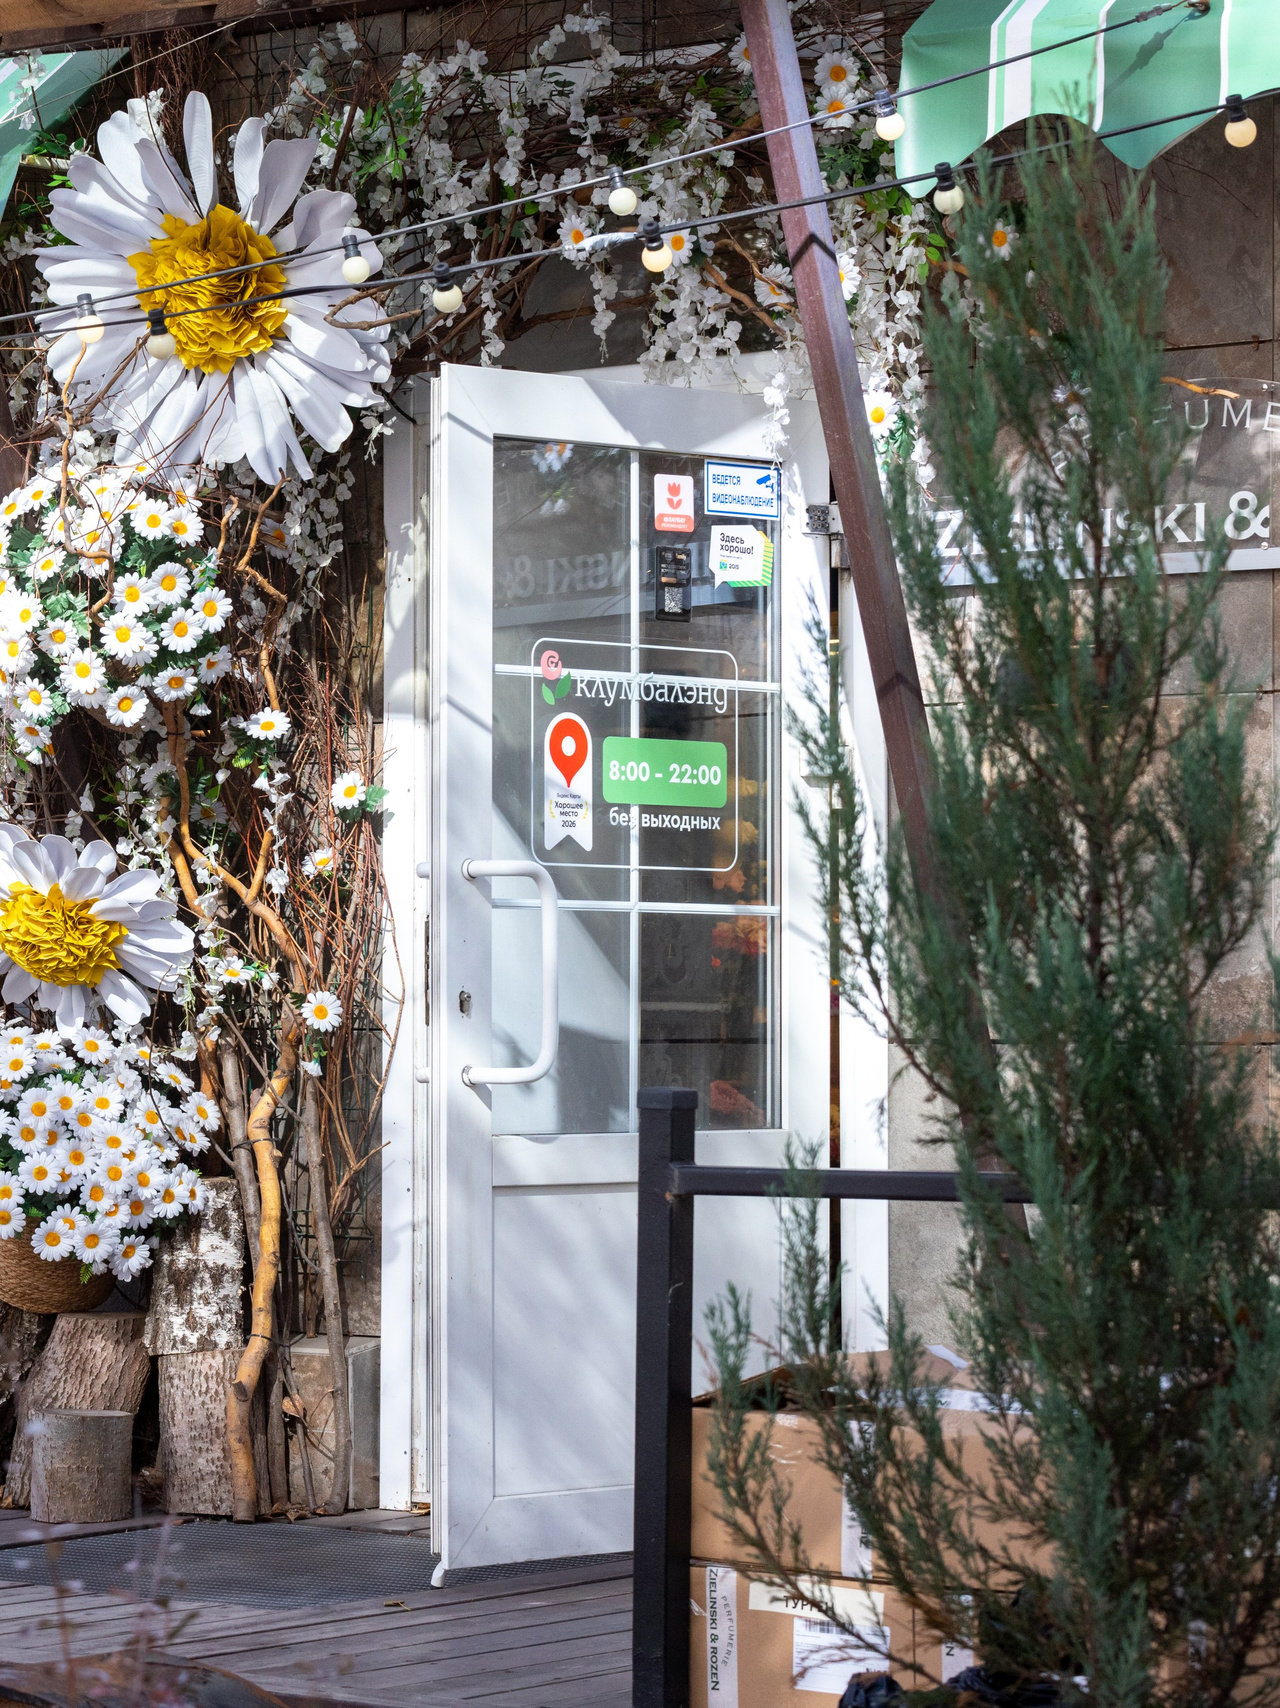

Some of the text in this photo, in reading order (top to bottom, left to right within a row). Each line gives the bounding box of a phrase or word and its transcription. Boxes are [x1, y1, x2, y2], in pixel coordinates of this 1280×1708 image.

[712, 474, 741, 486] ВЕДЕТСЯ
[712, 492, 774, 508] ВИДЕОНАБЛЮДЕНИЕ
[720, 533, 745, 545] Здесь
[720, 543, 754, 555] хорошо!
[575, 672, 728, 713] клумбалэнд
[609, 760, 650, 782] 8:00
[669, 763, 722, 786] 22:00
[554, 801, 584, 810] Хорошее
[562, 820, 577, 828] 2026
[641, 813, 721, 832] выходных
[709, 1568, 720, 1692] ZIELINSKI & ROZEN
[721, 1595, 735, 1667] PERFUMERIE
